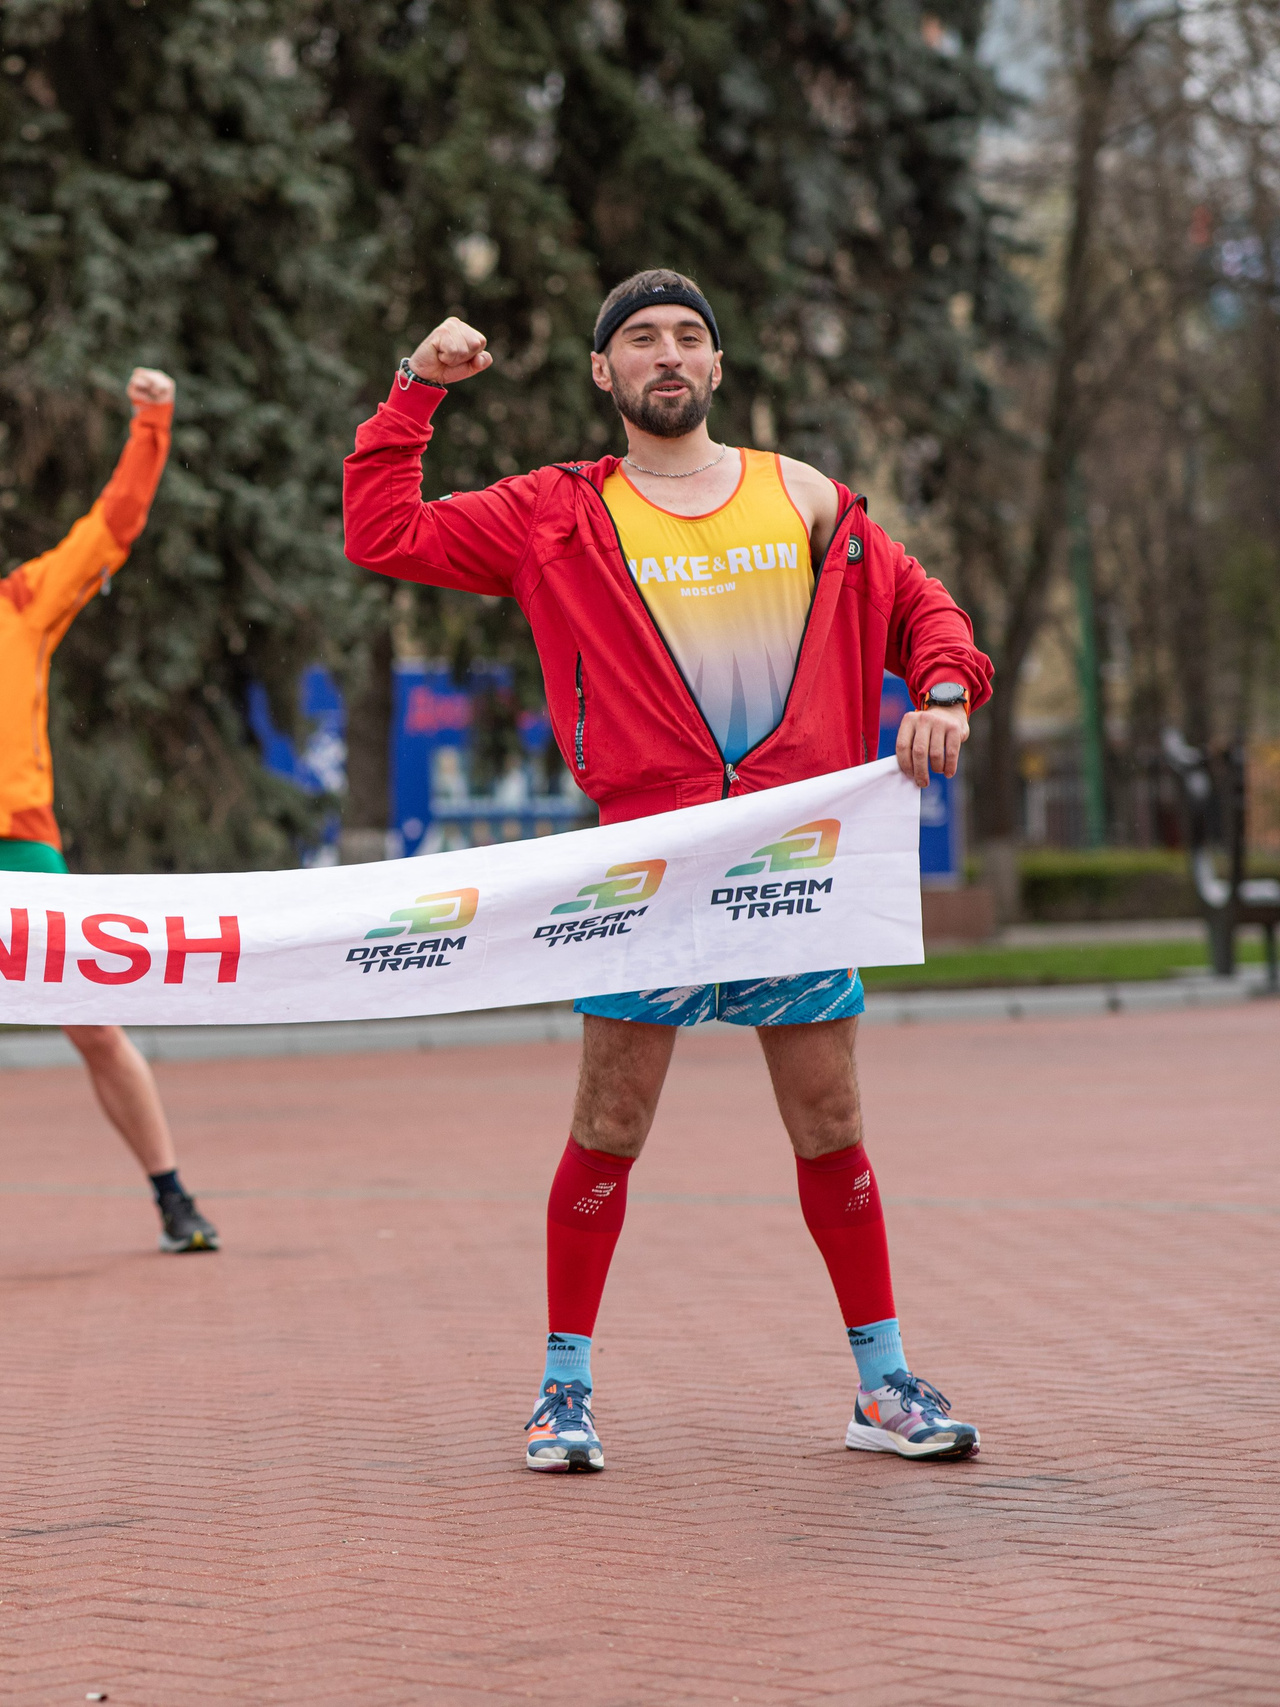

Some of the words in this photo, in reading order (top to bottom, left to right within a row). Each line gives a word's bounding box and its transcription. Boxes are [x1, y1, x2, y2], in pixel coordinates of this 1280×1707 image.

[680, 581, 736, 597] MOSCOW
[710, 877, 833, 905] DREAM
[532, 905, 649, 939] DREAM
[726, 898, 822, 921] TRAIL
[545, 922, 632, 947] TRAIL
[345, 936, 467, 962] DREAM
[359, 954, 451, 973] TRAIL
